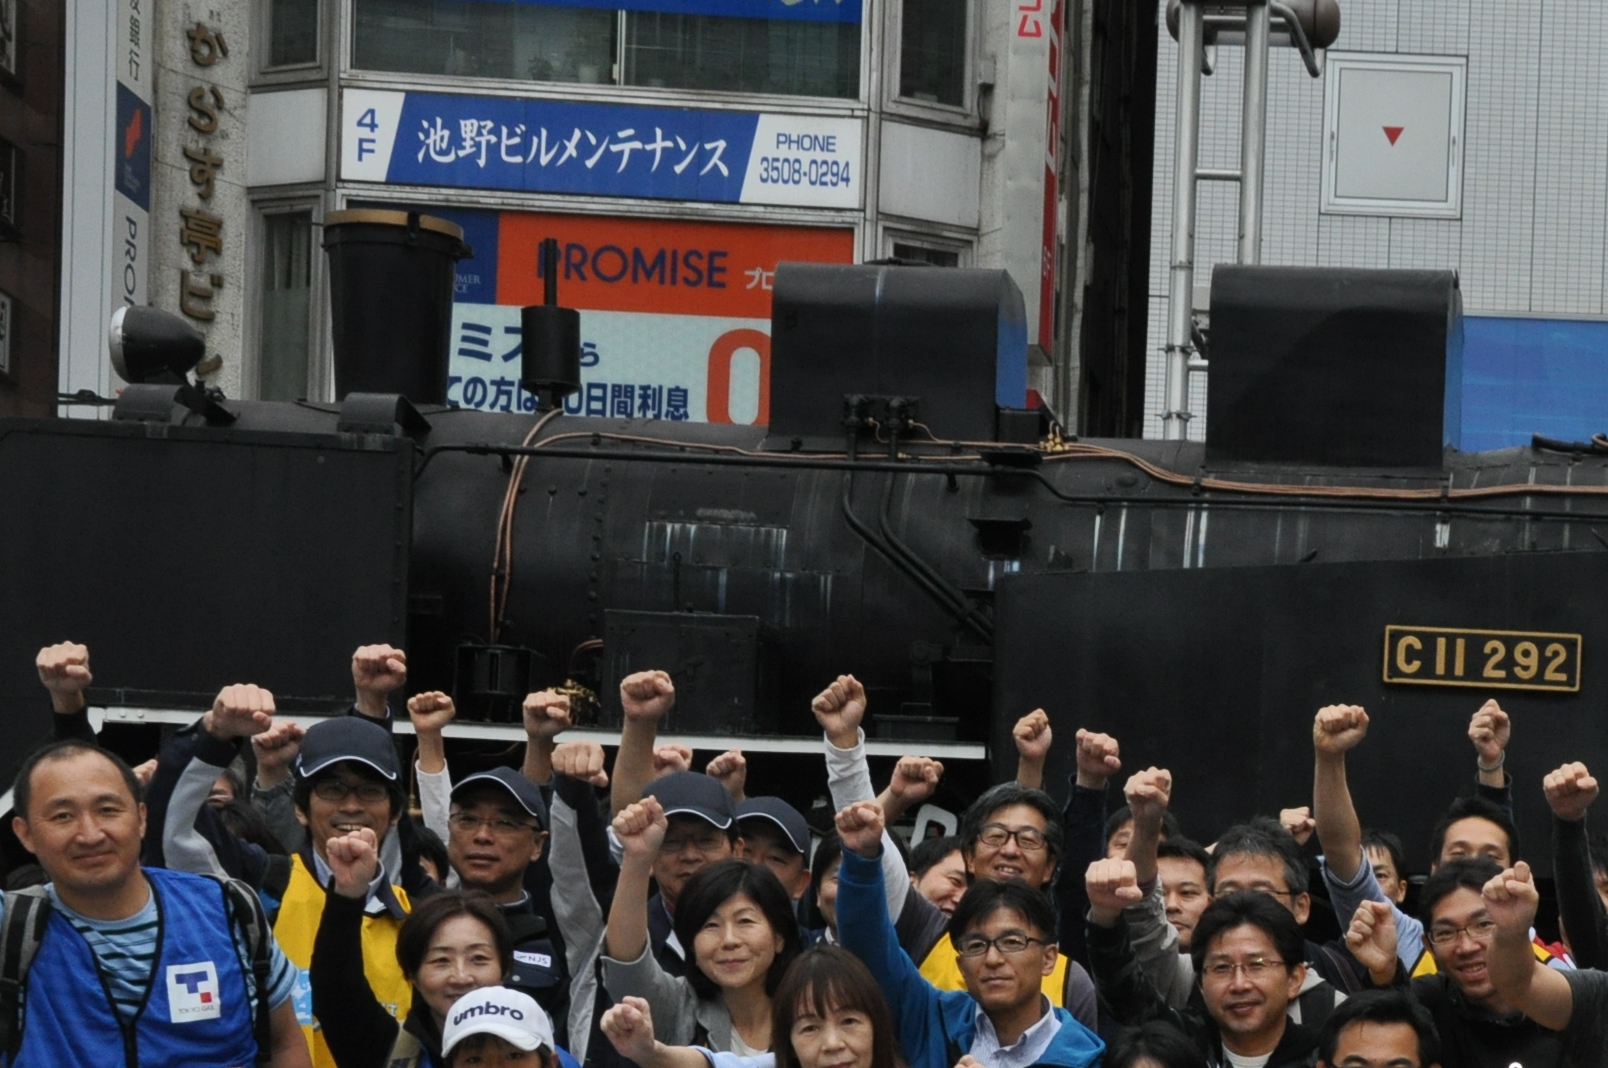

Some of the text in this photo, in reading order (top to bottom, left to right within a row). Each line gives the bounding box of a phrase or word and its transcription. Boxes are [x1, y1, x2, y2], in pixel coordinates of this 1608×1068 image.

[417, 116, 730, 178] 池野ビルメンテナンス
[776, 132, 837, 153] PHONE
[759, 156, 851, 188] 3508-0294
[180, 22, 229, 376] からす亭ビ
[1482, 639, 1568, 681] 292
[453, 1000, 525, 1027] umbro
